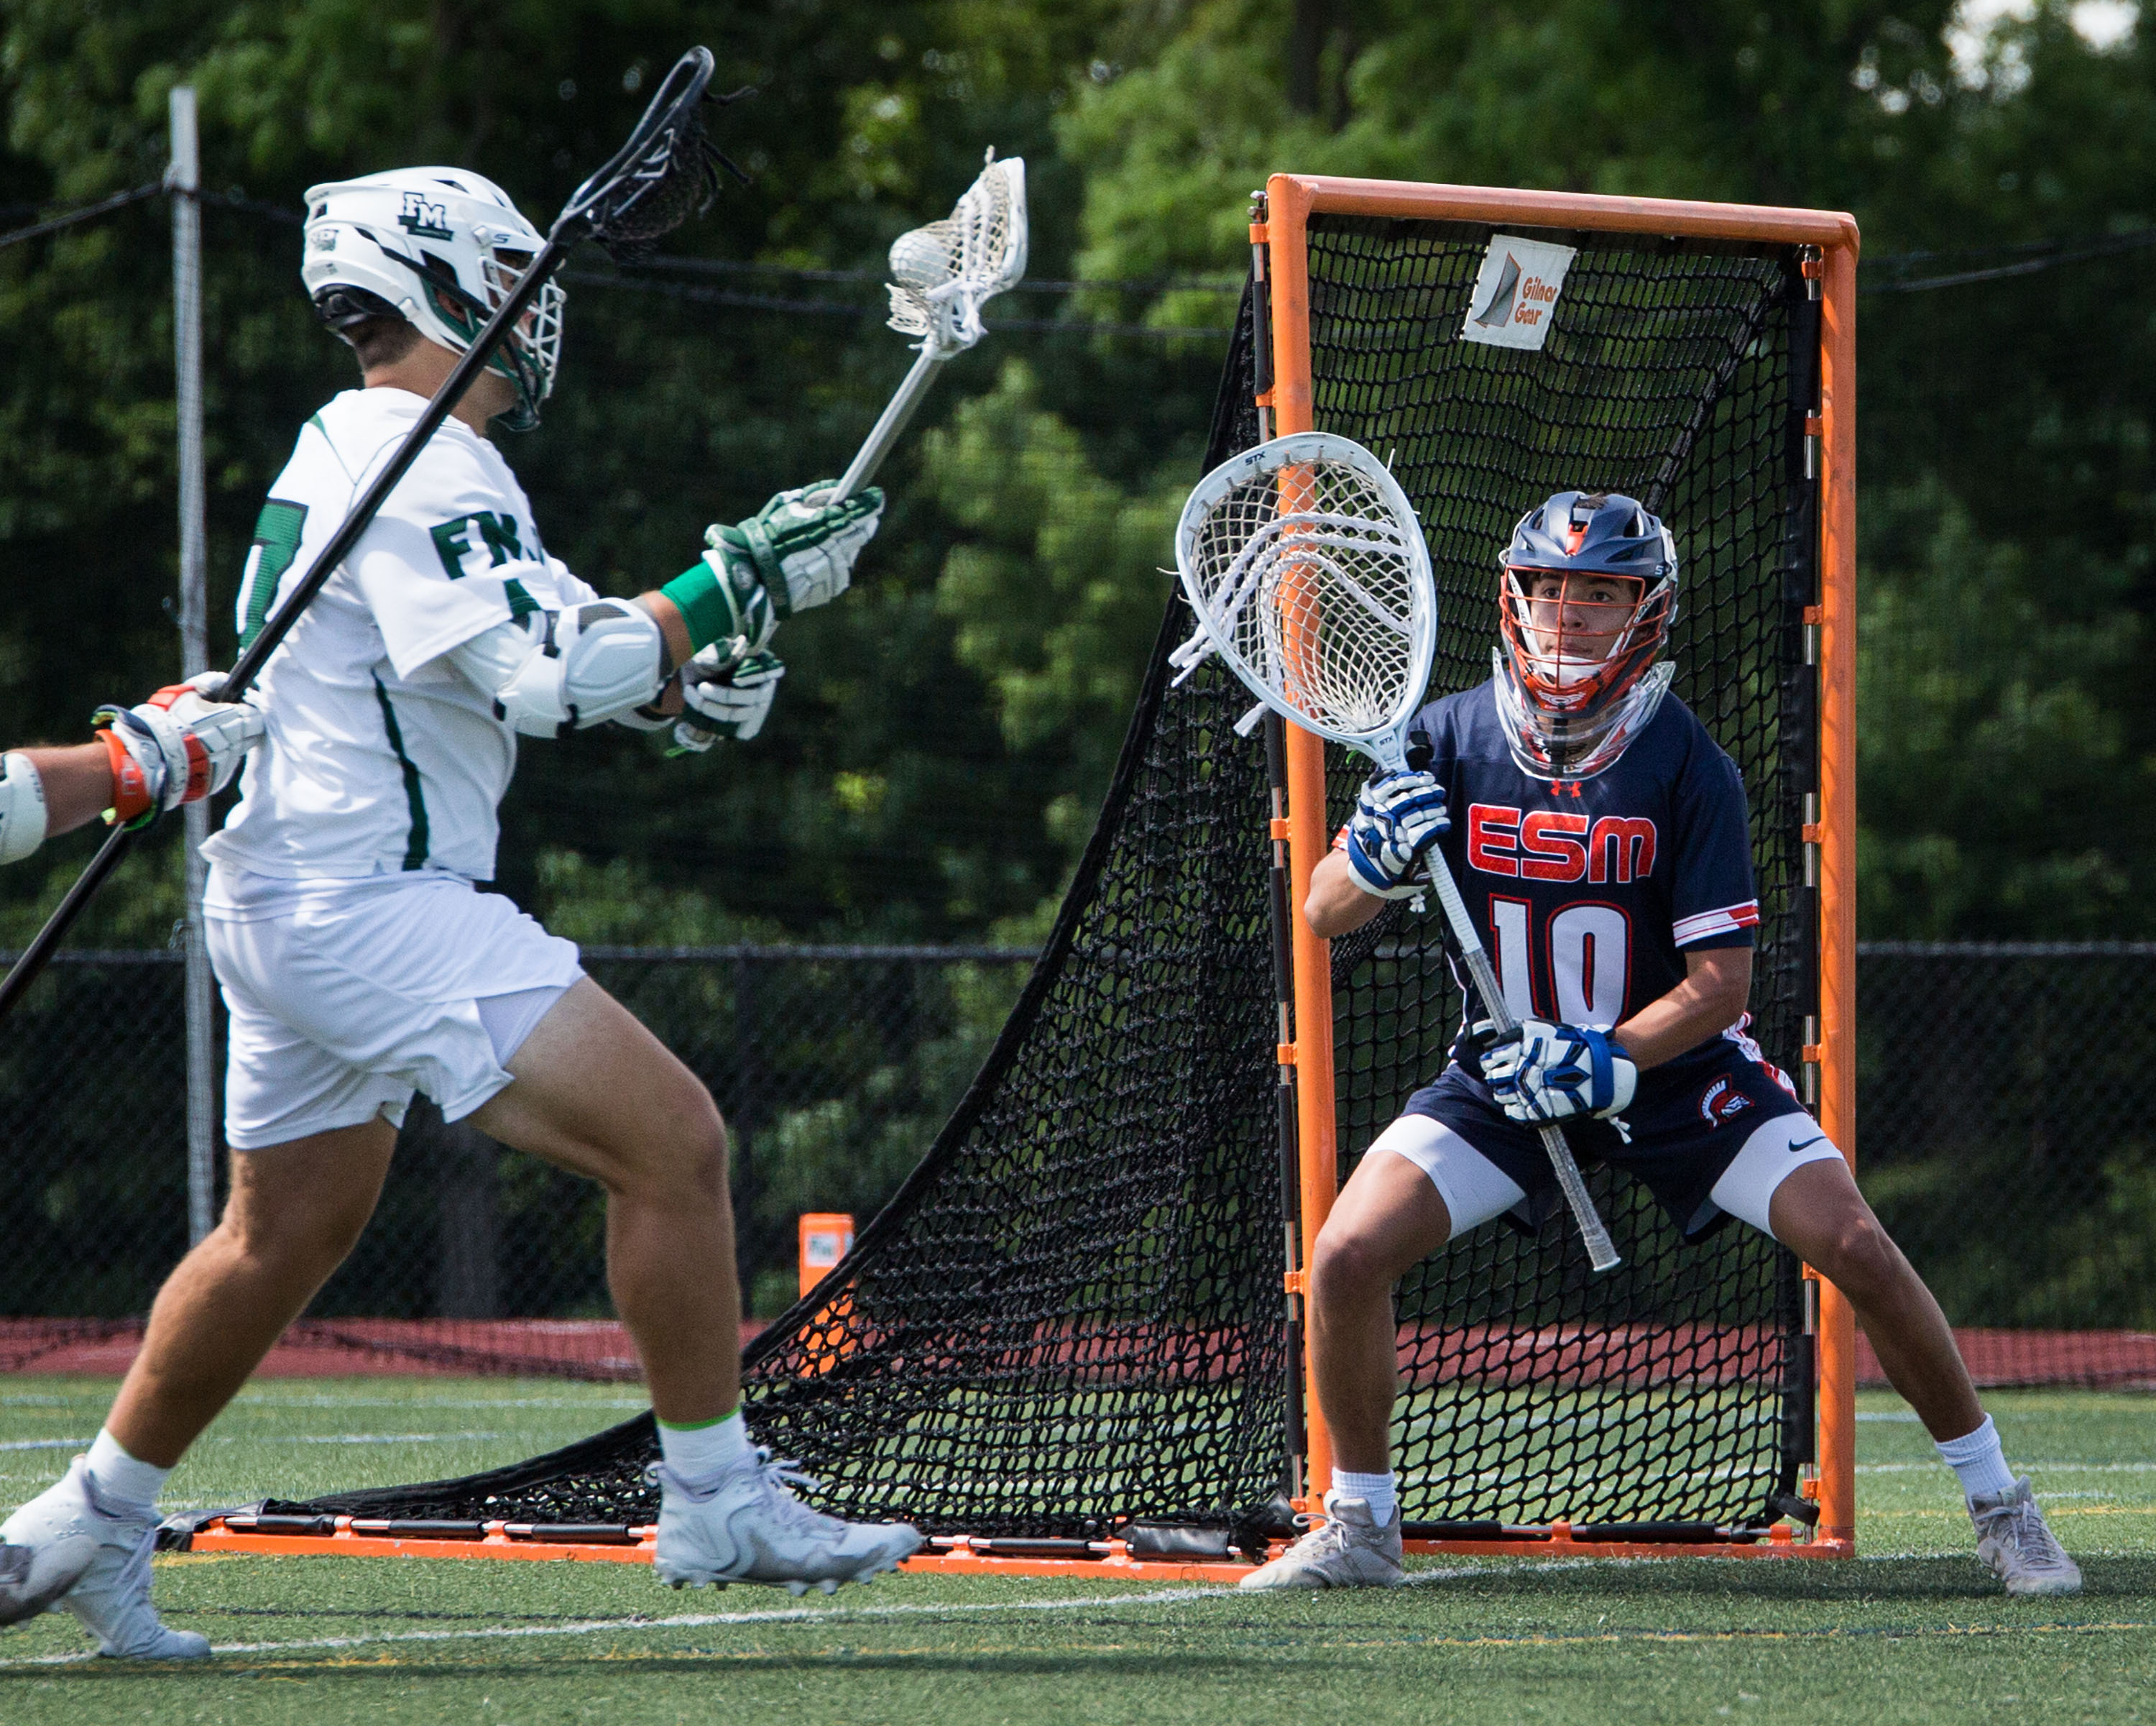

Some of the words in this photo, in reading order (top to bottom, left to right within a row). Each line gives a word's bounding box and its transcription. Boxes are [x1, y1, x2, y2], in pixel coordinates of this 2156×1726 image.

[404, 191, 446, 229] FM
[1515, 302, 1543, 325] Gear
[1245, 451, 1266, 466] STX
[1379, 735, 1393, 745] STX
[1468, 803, 1657, 883] ESM
[1488, 894, 1631, 1027] 10
